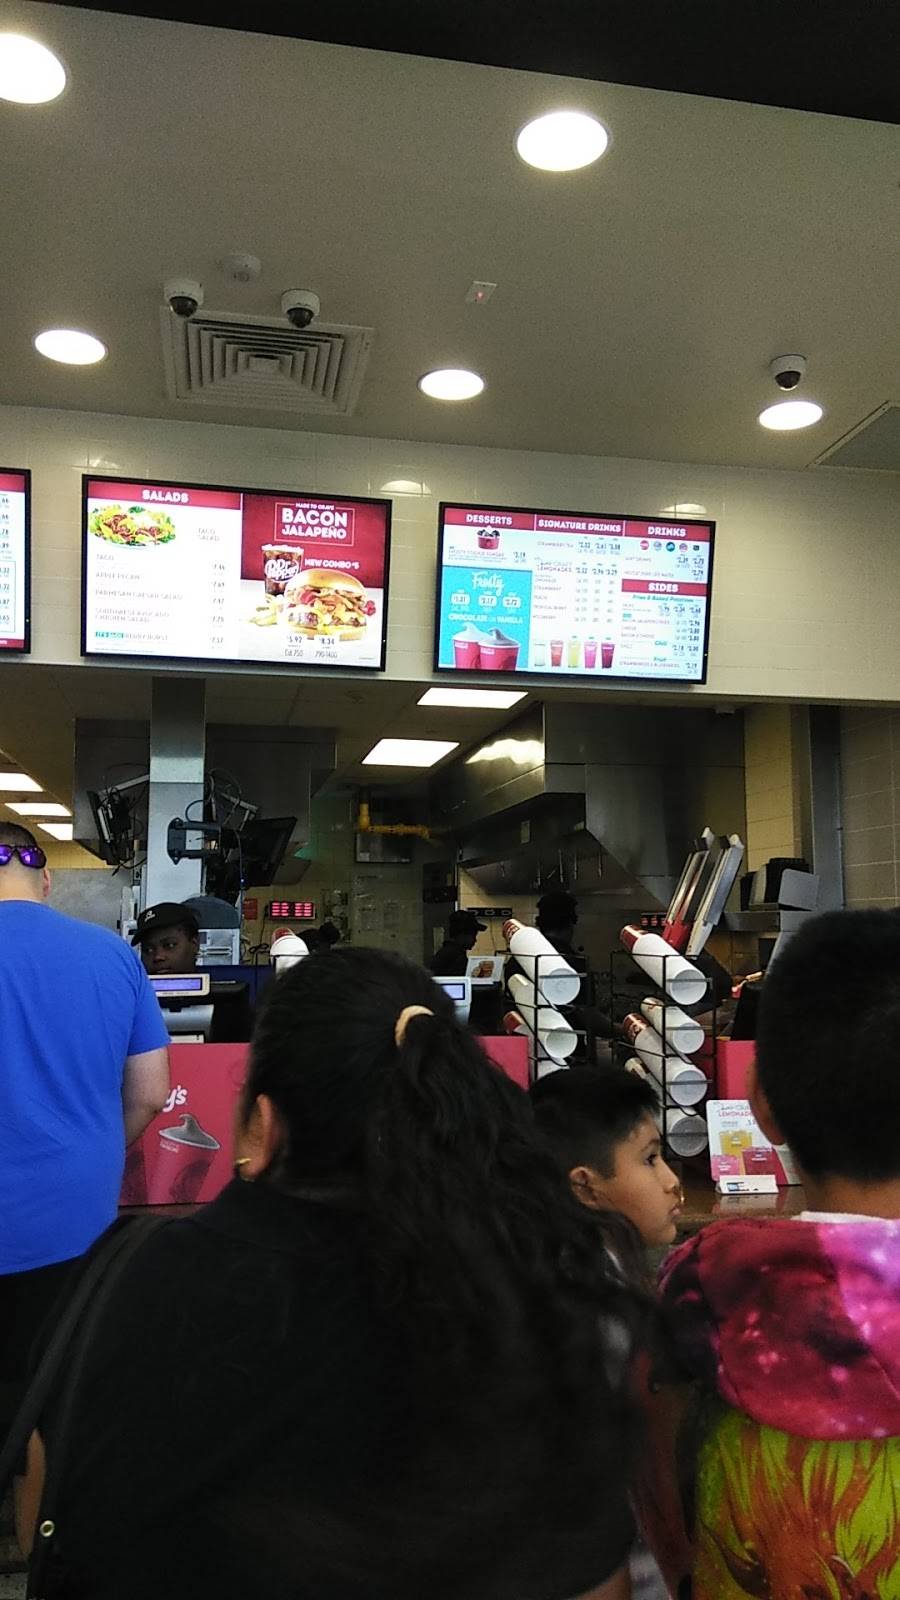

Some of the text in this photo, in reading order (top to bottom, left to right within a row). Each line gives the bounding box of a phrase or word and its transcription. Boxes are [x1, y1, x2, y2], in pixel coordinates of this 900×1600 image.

[142, 490, 189, 502] SALADS
[281, 507, 348, 527] BACON
[465, 514, 512, 526] DESSERTS
[538, 519, 621, 532] SIGNATURE DRINKS
[647, 526, 687, 537] DRINKS
[281, 525, 347, 539] JALAPEÑO
[304, 559, 322, 567] NEW
[323, 560, 351, 569] COMBO
[471, 571, 504, 596] Frosty
[648, 582, 679, 592] SIDES
